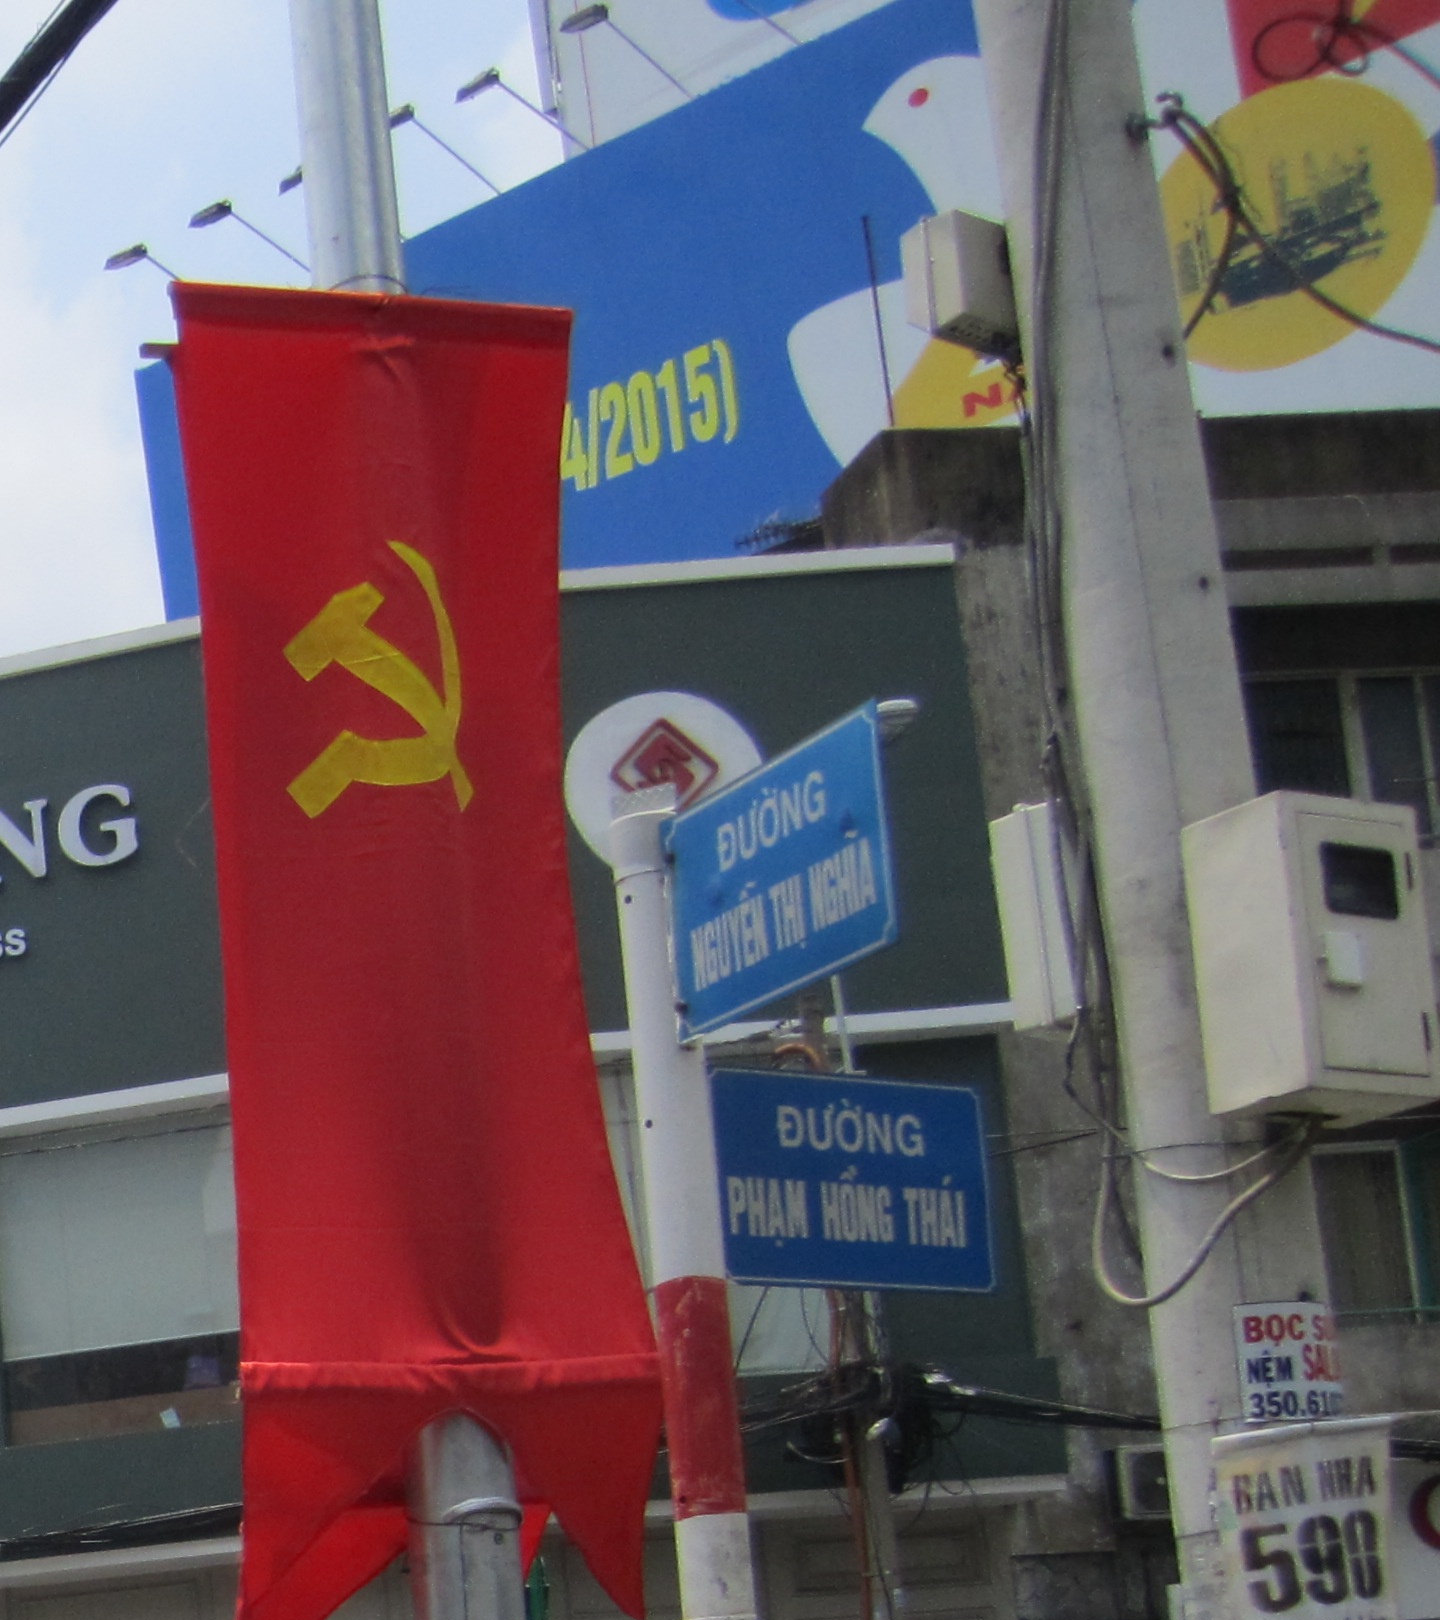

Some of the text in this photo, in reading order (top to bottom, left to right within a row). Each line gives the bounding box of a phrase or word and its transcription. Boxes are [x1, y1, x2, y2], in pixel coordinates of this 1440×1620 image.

[717, 771, 826, 873] ĐƯỜNG
[690, 830, 878, 993] NGUYỄN THỊ NGHĨA
[776, 1098, 925, 1157] ĐƯỜNG
[726, 1165, 968, 1249] PHẠM HỒNG THÁI
[1242, 1313, 1305, 1347] BỌC
[1245, 1350, 1294, 1388] NỆM
[1240, 1510, 1382, 1613] 590
